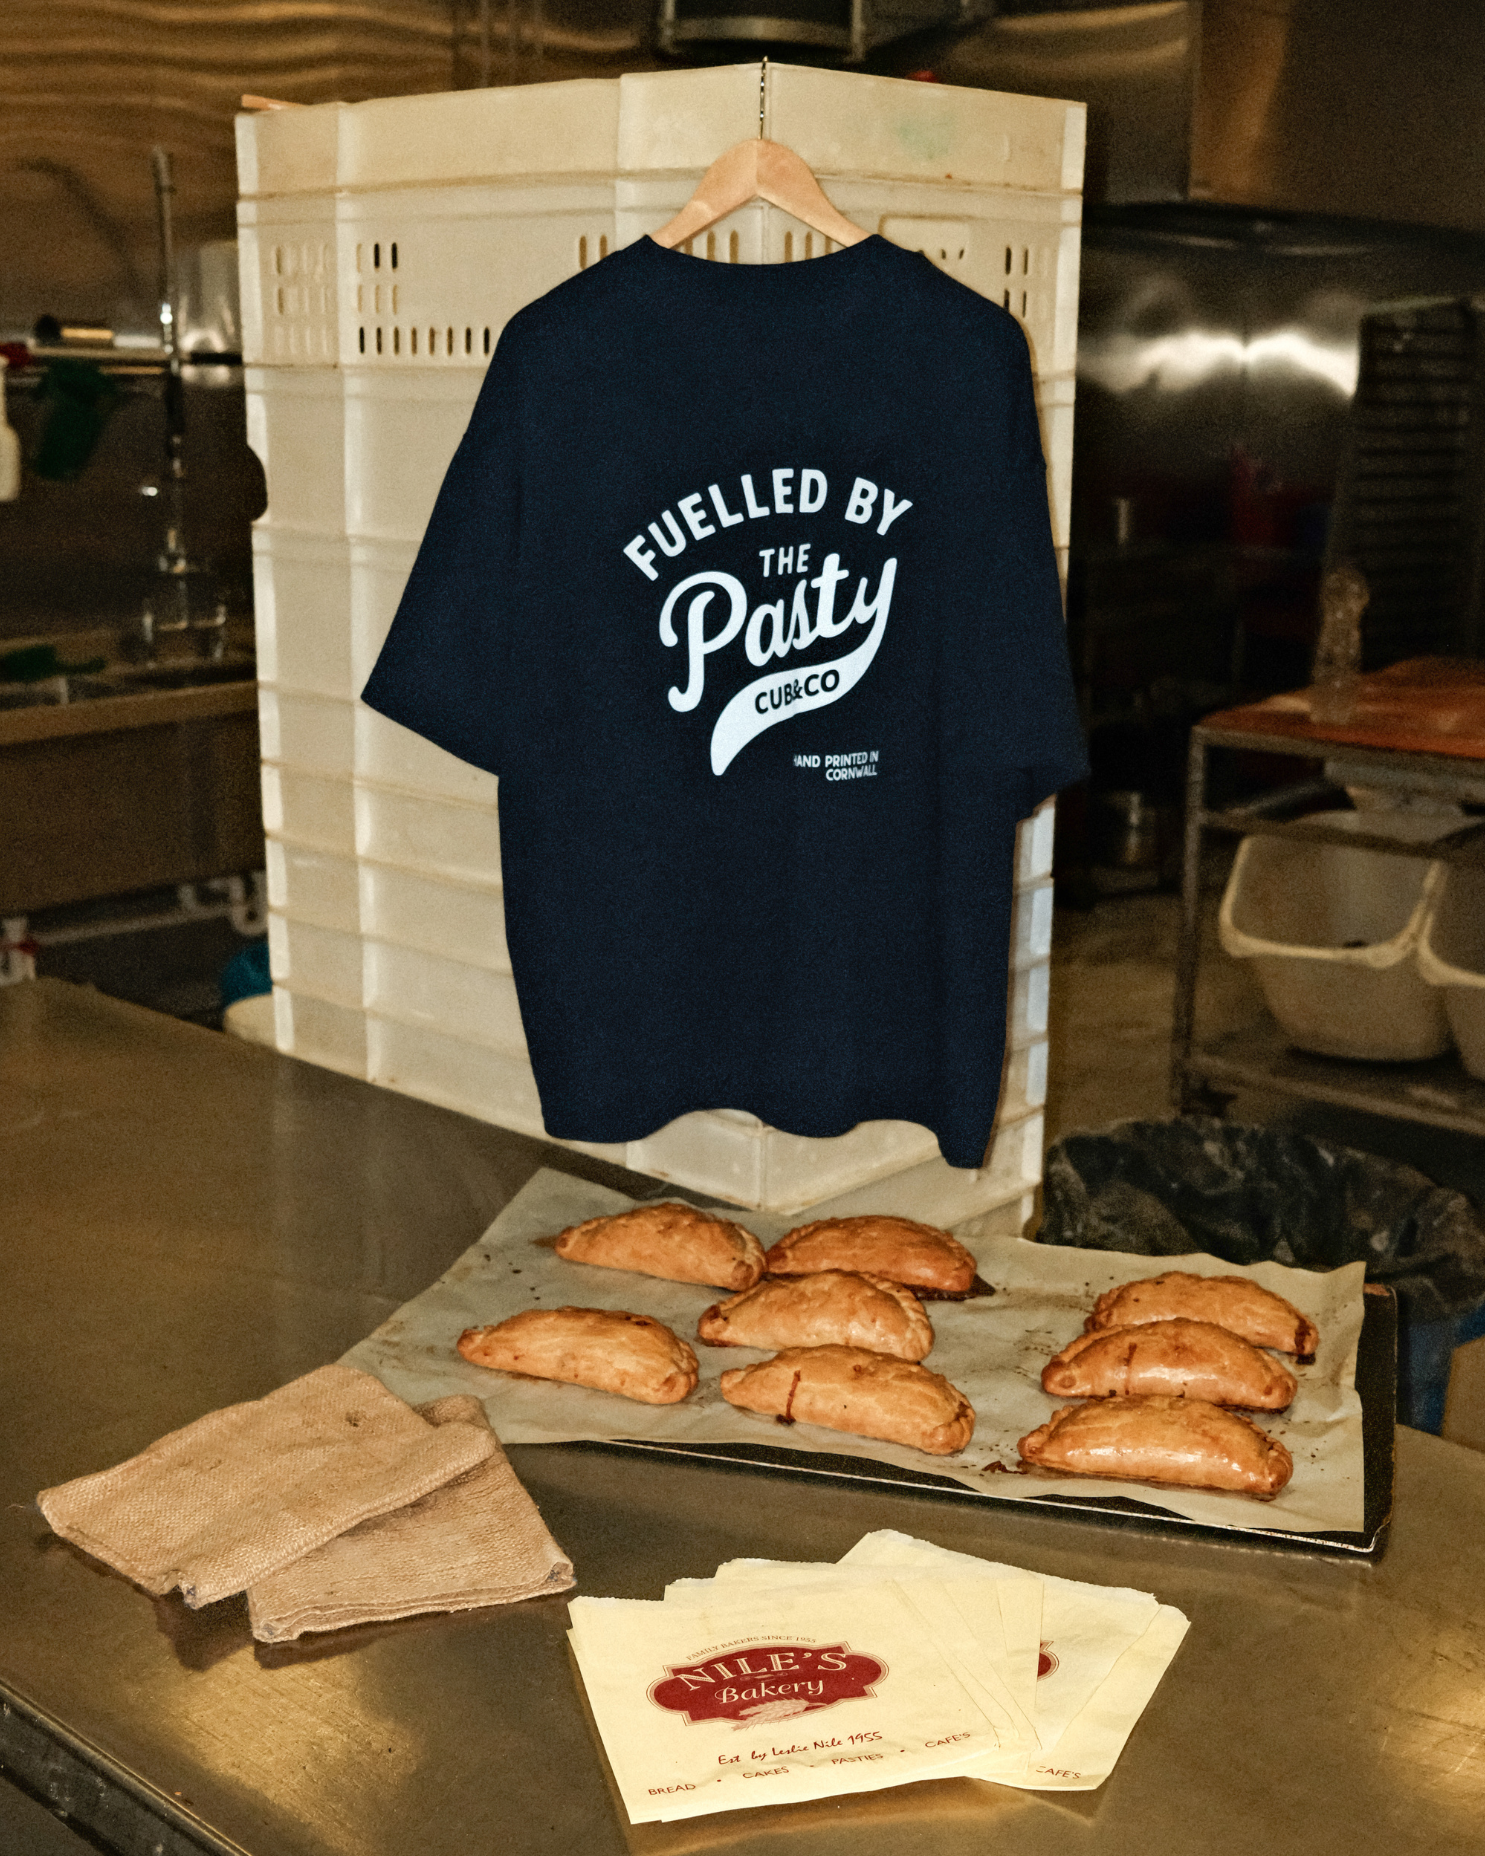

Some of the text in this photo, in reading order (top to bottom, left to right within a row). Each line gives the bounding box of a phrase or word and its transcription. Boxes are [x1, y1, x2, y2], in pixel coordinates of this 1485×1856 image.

[623, 468, 913, 581] FUELLED BY
[759, 543, 812, 578] THE
[659, 553, 898, 712] Pasty
[755, 669, 840, 714] CUB&CO
[825, 751, 868, 768] PRINTED
[869, 750, 879, 763] IN
[826, 764, 878, 781] CORNWALL
[685, 1644, 719, 1661] FAMILY
[721, 1635, 760, 1649] BAKERS
[795, 1635, 817, 1643] 1955
[674, 1652, 847, 1691] NILE'S
[714, 1680, 824, 1704] Bakery
[648, 1732, 971, 1796] BREAD CAKES PASTIES CAFE'S
[718, 1731, 883, 1765] Est by Leslie Nile 1955
